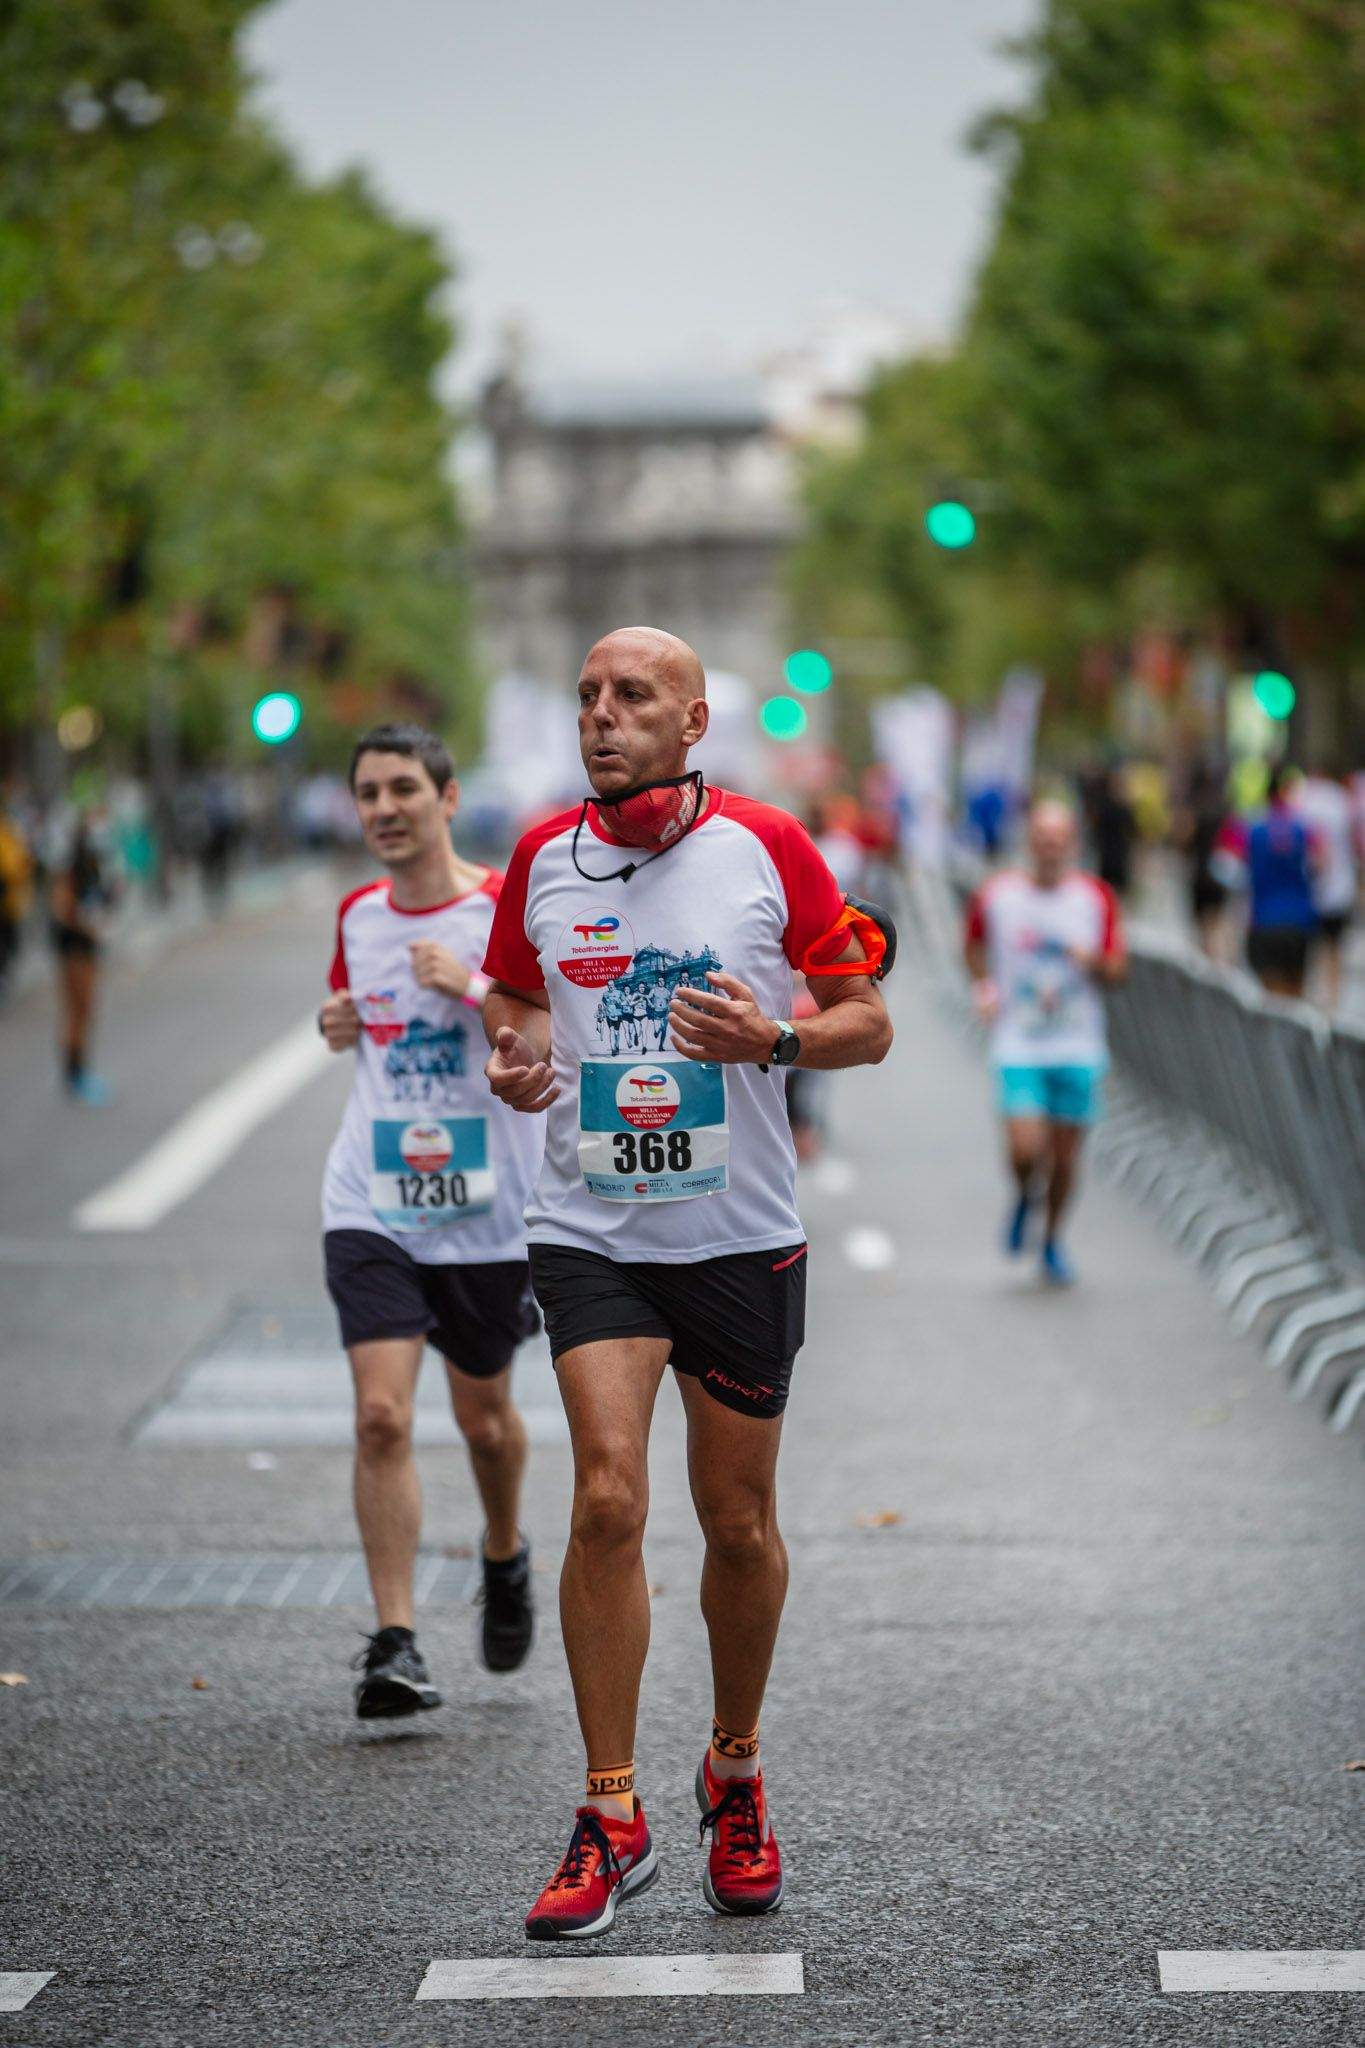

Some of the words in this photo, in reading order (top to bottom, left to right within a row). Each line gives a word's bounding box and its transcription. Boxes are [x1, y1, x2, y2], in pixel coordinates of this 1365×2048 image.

[571, 944, 619, 954] TotalEnergies
[582, 959, 606, 967] MILLA
[612, 1130, 692, 1175] 368
[396, 1173, 468, 1208] 1230
